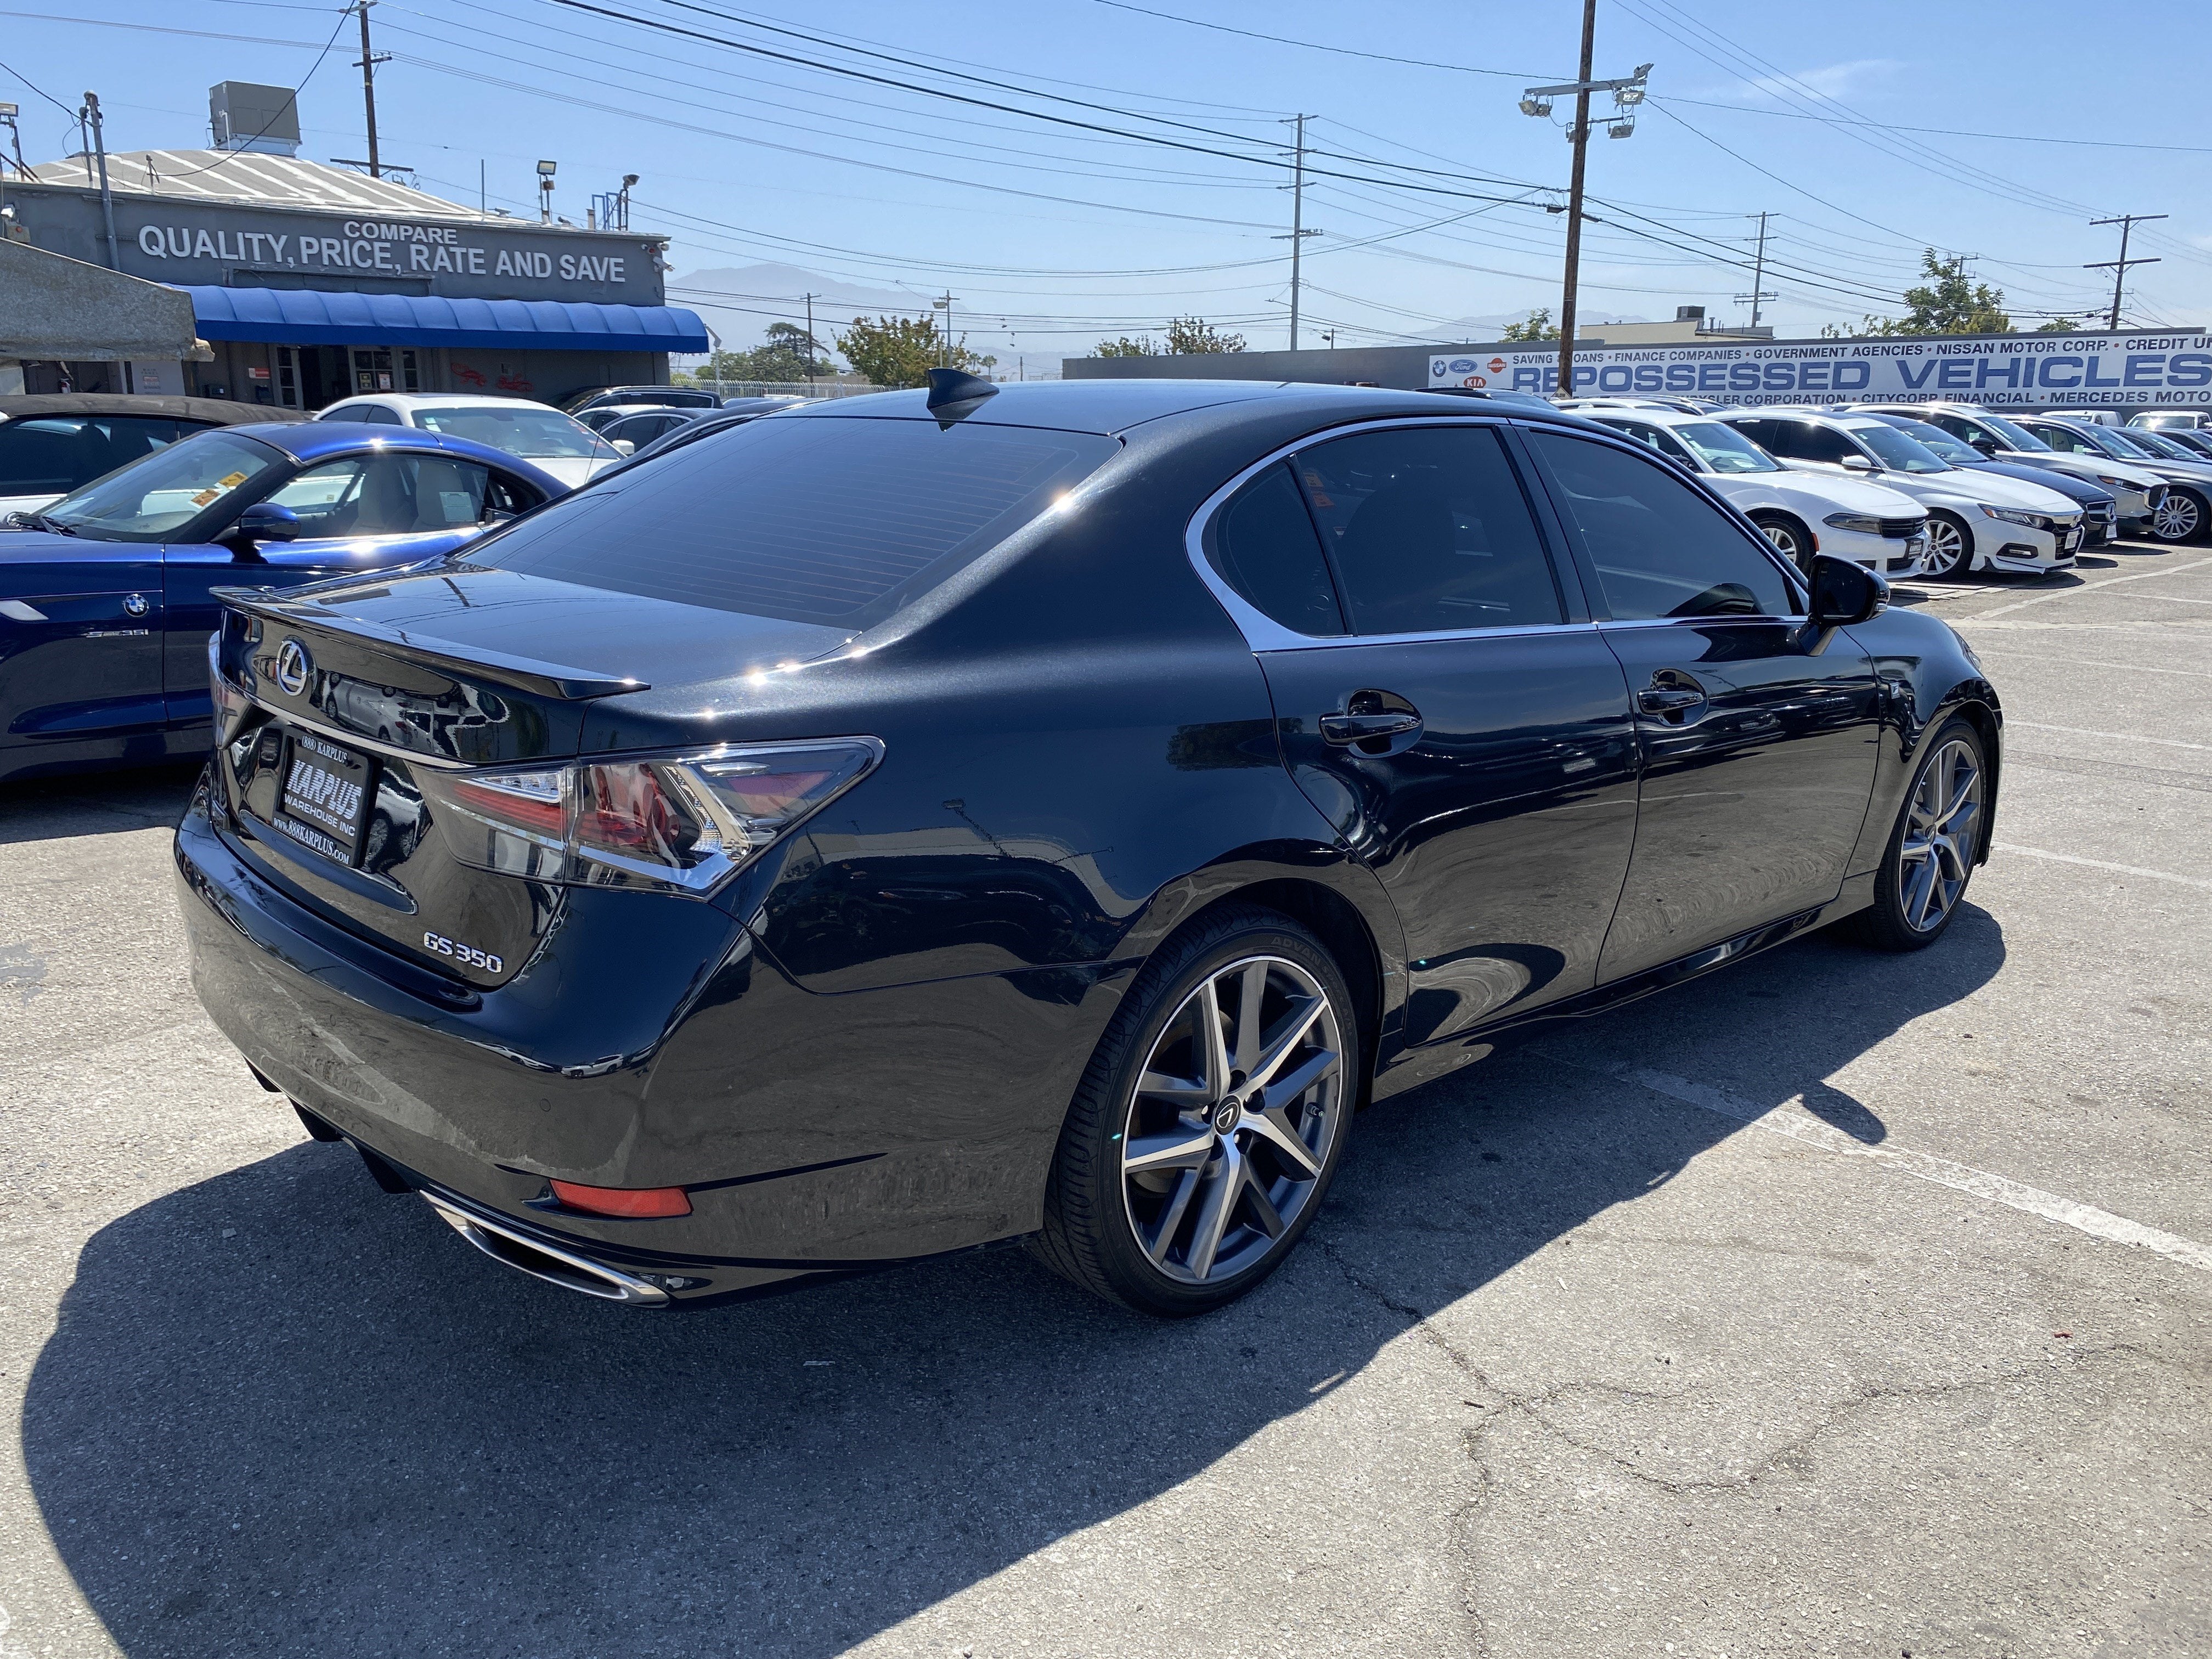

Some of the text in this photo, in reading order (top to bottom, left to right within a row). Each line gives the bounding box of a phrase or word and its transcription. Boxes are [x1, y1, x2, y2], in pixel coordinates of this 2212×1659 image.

[343, 221, 458, 245] COMPARE
[138, 225, 625, 282] QUALITY, PRICE, RATE AND SAVE
[1513, 354, 1553, 364] SAVING
[1573, 353, 1604, 363] OANS
[1615, 352, 1666, 362] FINANCE
[1669, 349, 1741, 361] COMPANIES
[1753, 347, 1848, 359] GOVERNMENT
[1851, 345, 1923, 357] AGENCIES
[1936, 343, 1995, 354] NISSAN
[1999, 341, 2057, 353] MOTOR
[2062, 340, 2108, 351] CORP.
[2125, 337, 2188, 350] CREDIT
[1454, 362, 1472, 370] Ford
[1513, 353, 2212, 392] REPOSSESSED VEHICLES
[1466, 378, 1484, 387] KIA
[1744, 394, 1846, 404] CORPORATION
[1861, 393, 1938, 403] CITYCORP
[1944, 393, 2034, 403] FINANCIAL
[2050, 391, 2148, 403] MERCEDES
[2155, 391, 2211, 403] MOTO
[302, 735, 348, 764] (888) KARPLUS
[286, 759, 363, 820] KARPLUS
[284, 793, 356, 837] WAREHOUSE INC
[424, 932, 503, 973] GS 350
[1270, 936, 1322, 966] ADVAN
